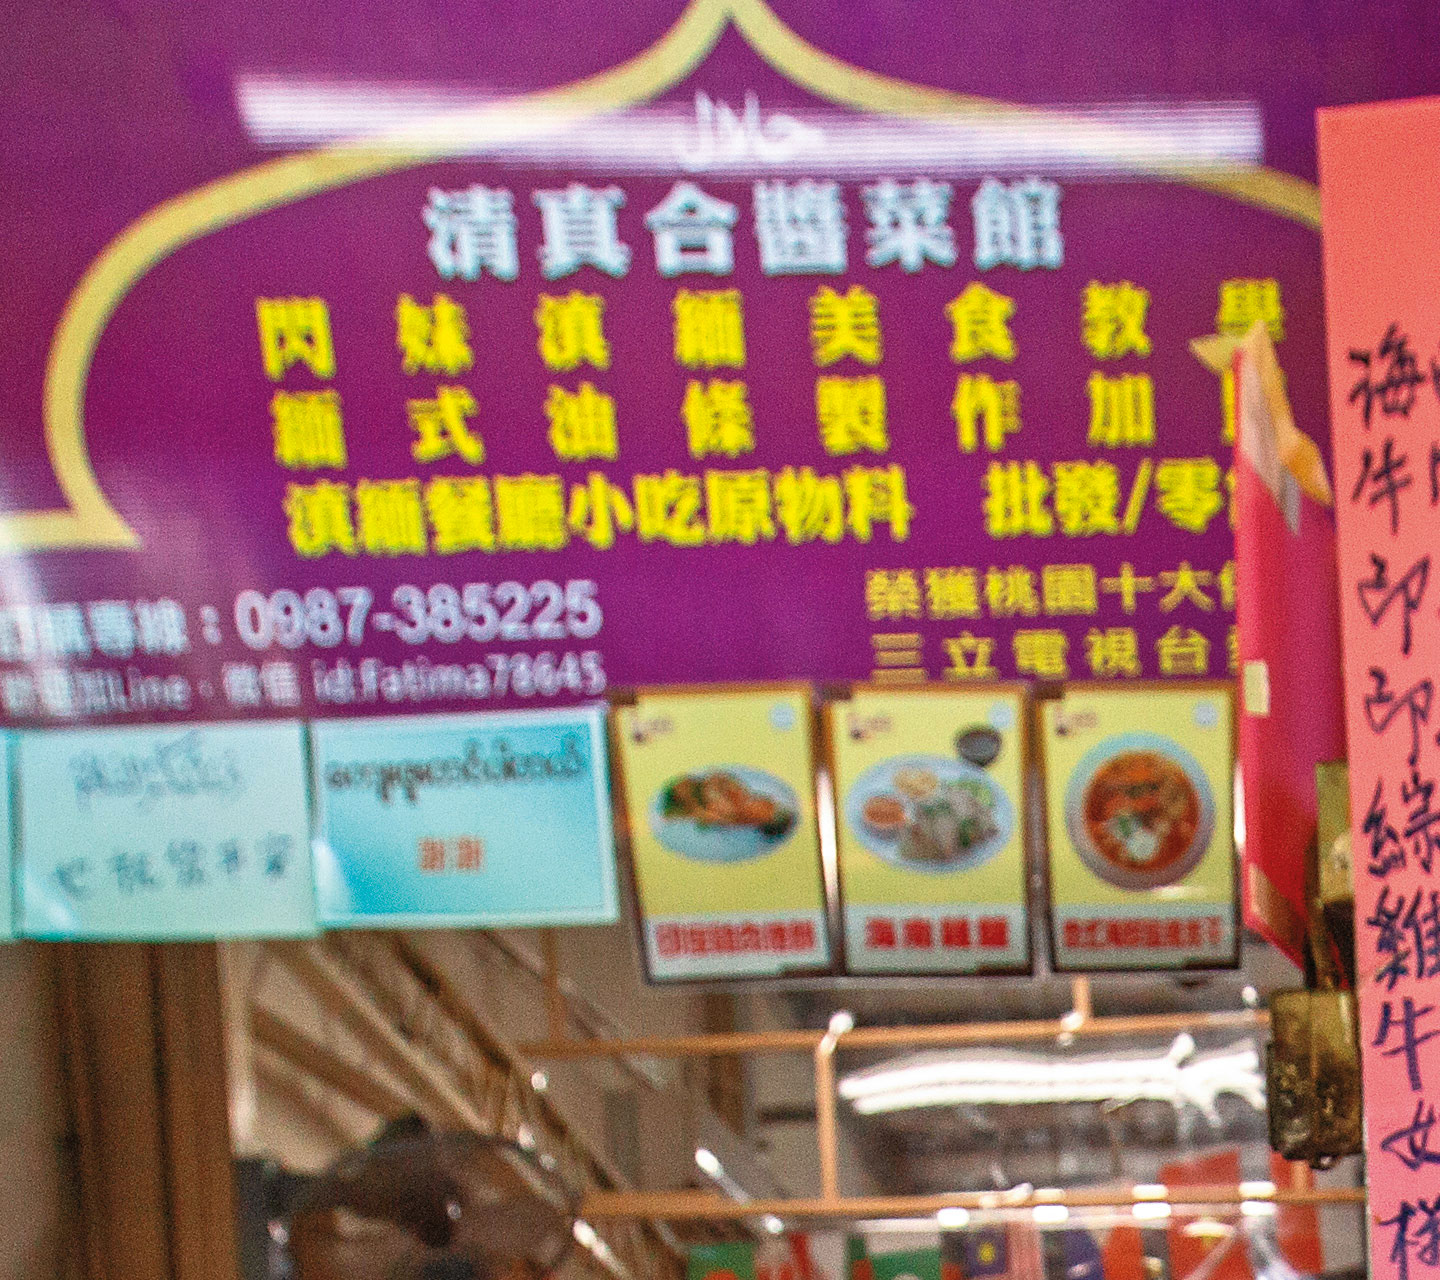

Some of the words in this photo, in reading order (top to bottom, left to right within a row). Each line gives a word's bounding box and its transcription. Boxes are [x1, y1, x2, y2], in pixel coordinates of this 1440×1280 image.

[424, 178, 1065, 280] 清真合醬菜館
[270, 371, 1238, 469] 緬式油條製作加
[983, 457, 1234, 539] 批發/零
[234, 577, 604, 652] 0987-385225
[869, 623, 1238, 684] 三立電視台
